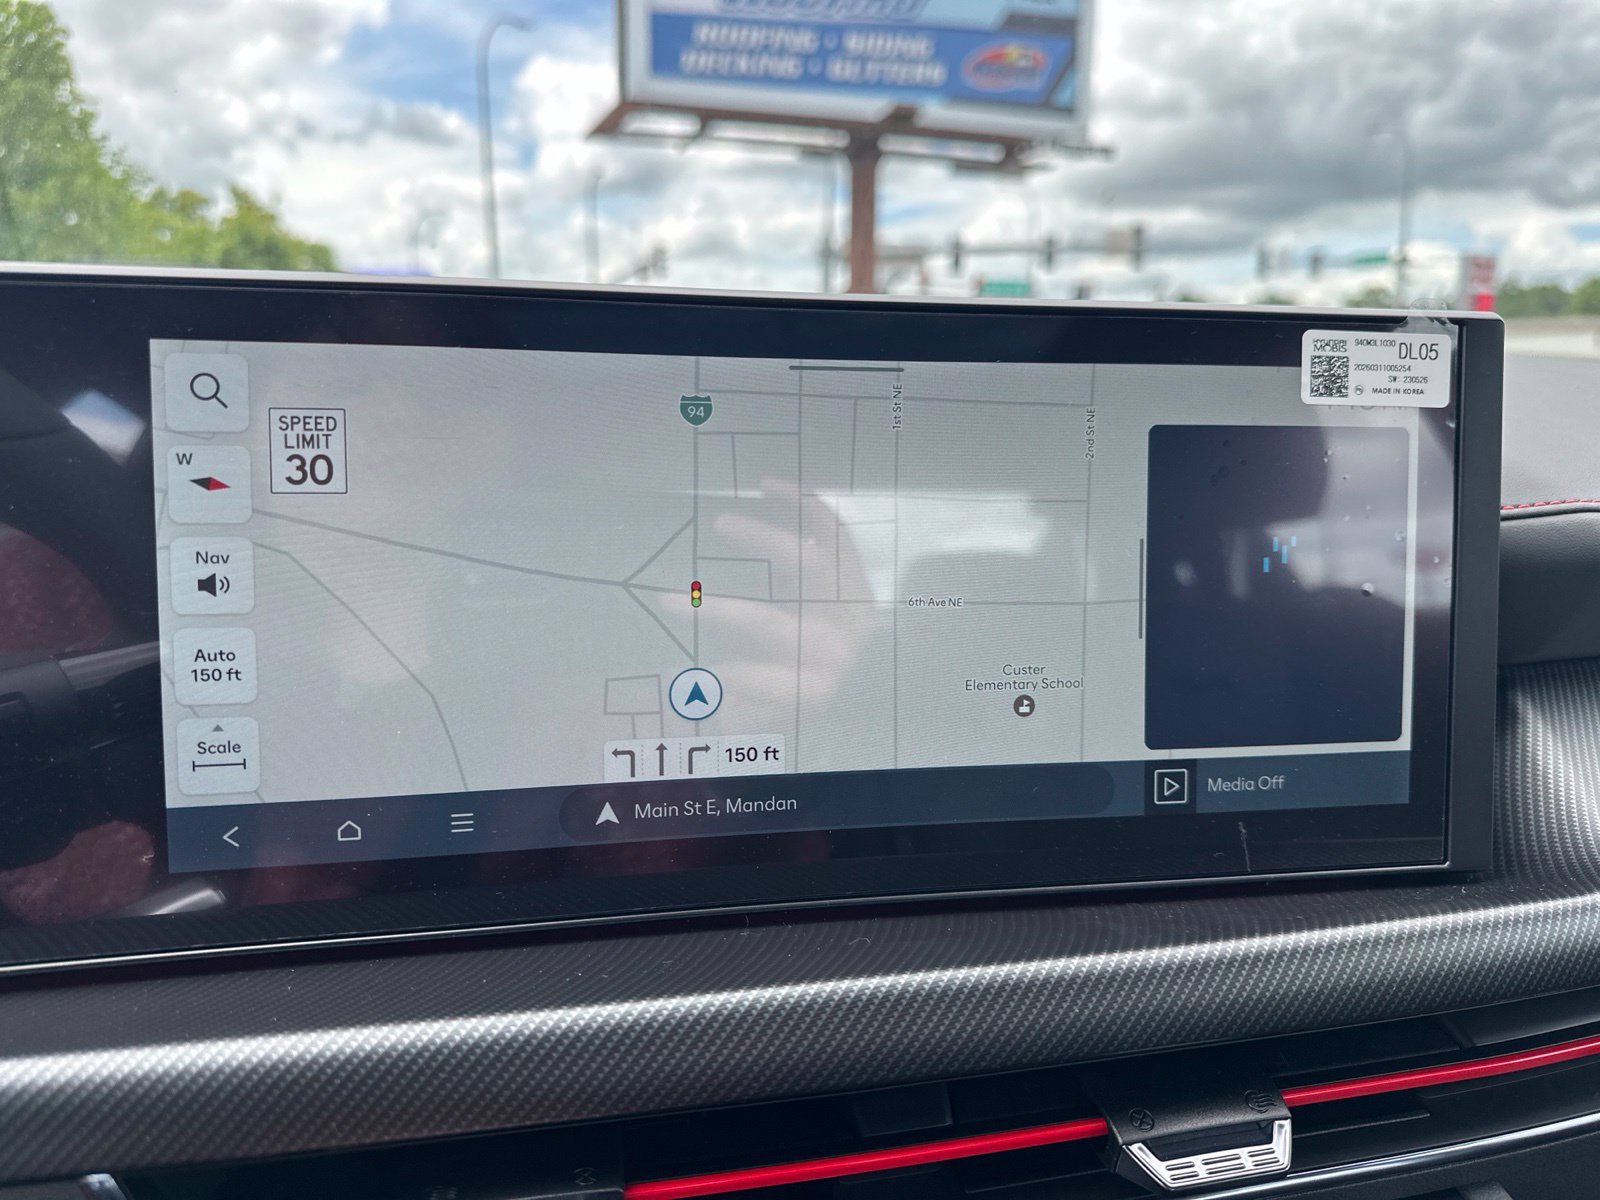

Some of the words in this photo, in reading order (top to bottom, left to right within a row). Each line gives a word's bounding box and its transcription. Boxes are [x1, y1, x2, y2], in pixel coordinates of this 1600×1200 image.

[1313, 344, 1347, 353] MOBIS
[1398, 342, 1439, 361] DL05
[892, 384, 902, 398] NE
[687, 405, 705, 418] 94
[892, 402, 902, 412] St
[892, 415, 902, 430] 1st
[1086, 407, 1096, 423] NE
[278, 415, 337, 432] SPEED
[1086, 425, 1095, 436] St
[284, 433, 332, 449] LIMIT
[1085, 439, 1095, 459] 2nd
[176, 453, 193, 465] W
[285, 454, 334, 486] 30
[195, 551, 230, 565] Nav
[908, 597, 925, 607] 6th
[928, 598, 946, 607] Ave
[948, 598, 963, 607] NE
[194, 649, 236, 662] Auto
[191, 668, 222, 682] 150
[226, 668, 242, 681] ft
[1002, 664, 1046, 676] Custer
[965, 678, 1038, 692] Elementary
[1041, 677, 1084, 689] School
[197, 740, 241, 755] Scale
[725, 747, 758, 763] 150
[763, 747, 780, 761] ft
[1207, 776, 1254, 792] Media
[1258, 775, 1286, 790] Off
[634, 802, 679, 819] Main
[683, 801, 704, 816] St
[706, 799, 721, 817] E,
[726, 796, 798, 814] Mandan
